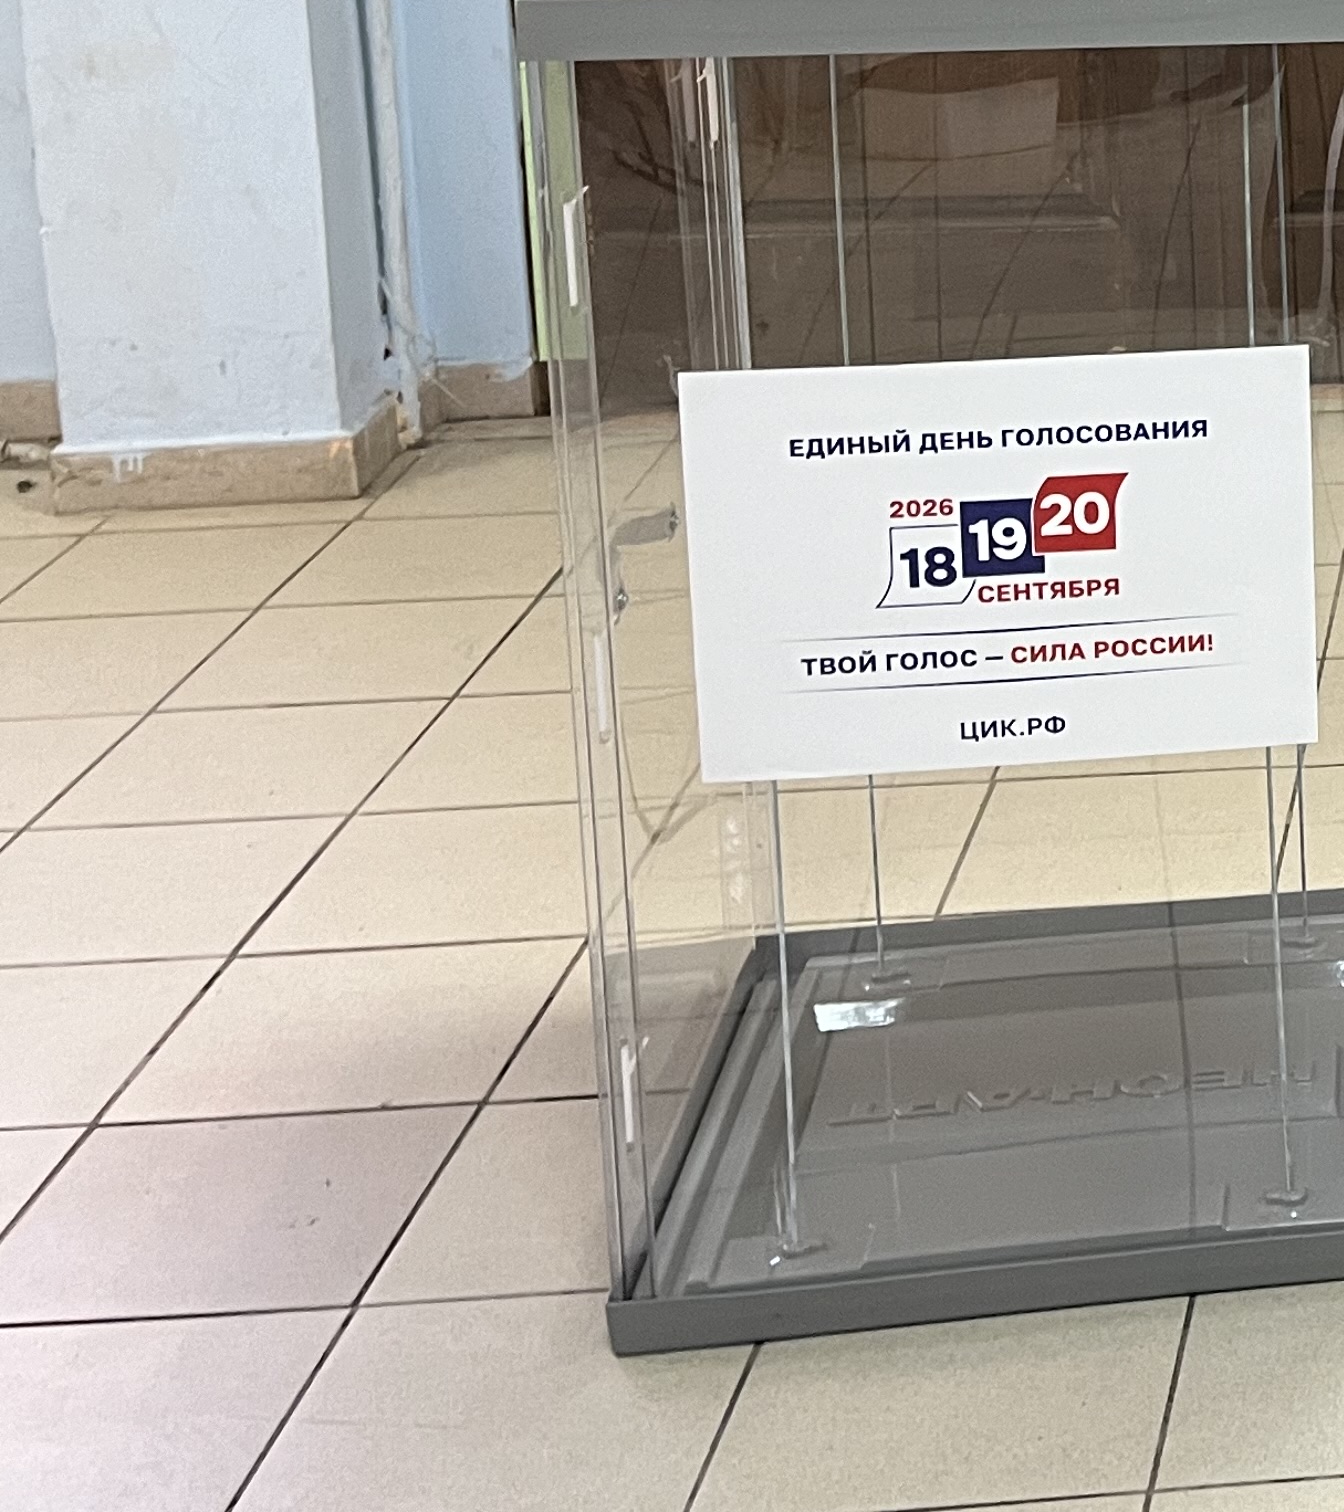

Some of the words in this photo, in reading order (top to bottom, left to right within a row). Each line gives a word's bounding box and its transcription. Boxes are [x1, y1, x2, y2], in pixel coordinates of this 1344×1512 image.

[788, 428, 912, 459] ЕДИНЫЙ
[918, 427, 994, 456] ДЕНЬ
[1001, 419, 1209, 449] ГОЛОСОВАНИЯ
[889, 498, 954, 519] 2026
[899, 546, 957, 589] 18
[968, 518, 1028, 562] 19
[1039, 491, 1111, 536] 20
[977, 577, 1120, 604] СЕНТЯБРЯ
[801, 649, 878, 678] ТВОЙ
[885, 648, 978, 672] ГОЛОС
[1011, 642, 1086, 666] СИЛА
[1094, 633, 1215, 660] РОССИИ!
[959, 714, 1067, 743] ЦИК.РФ
